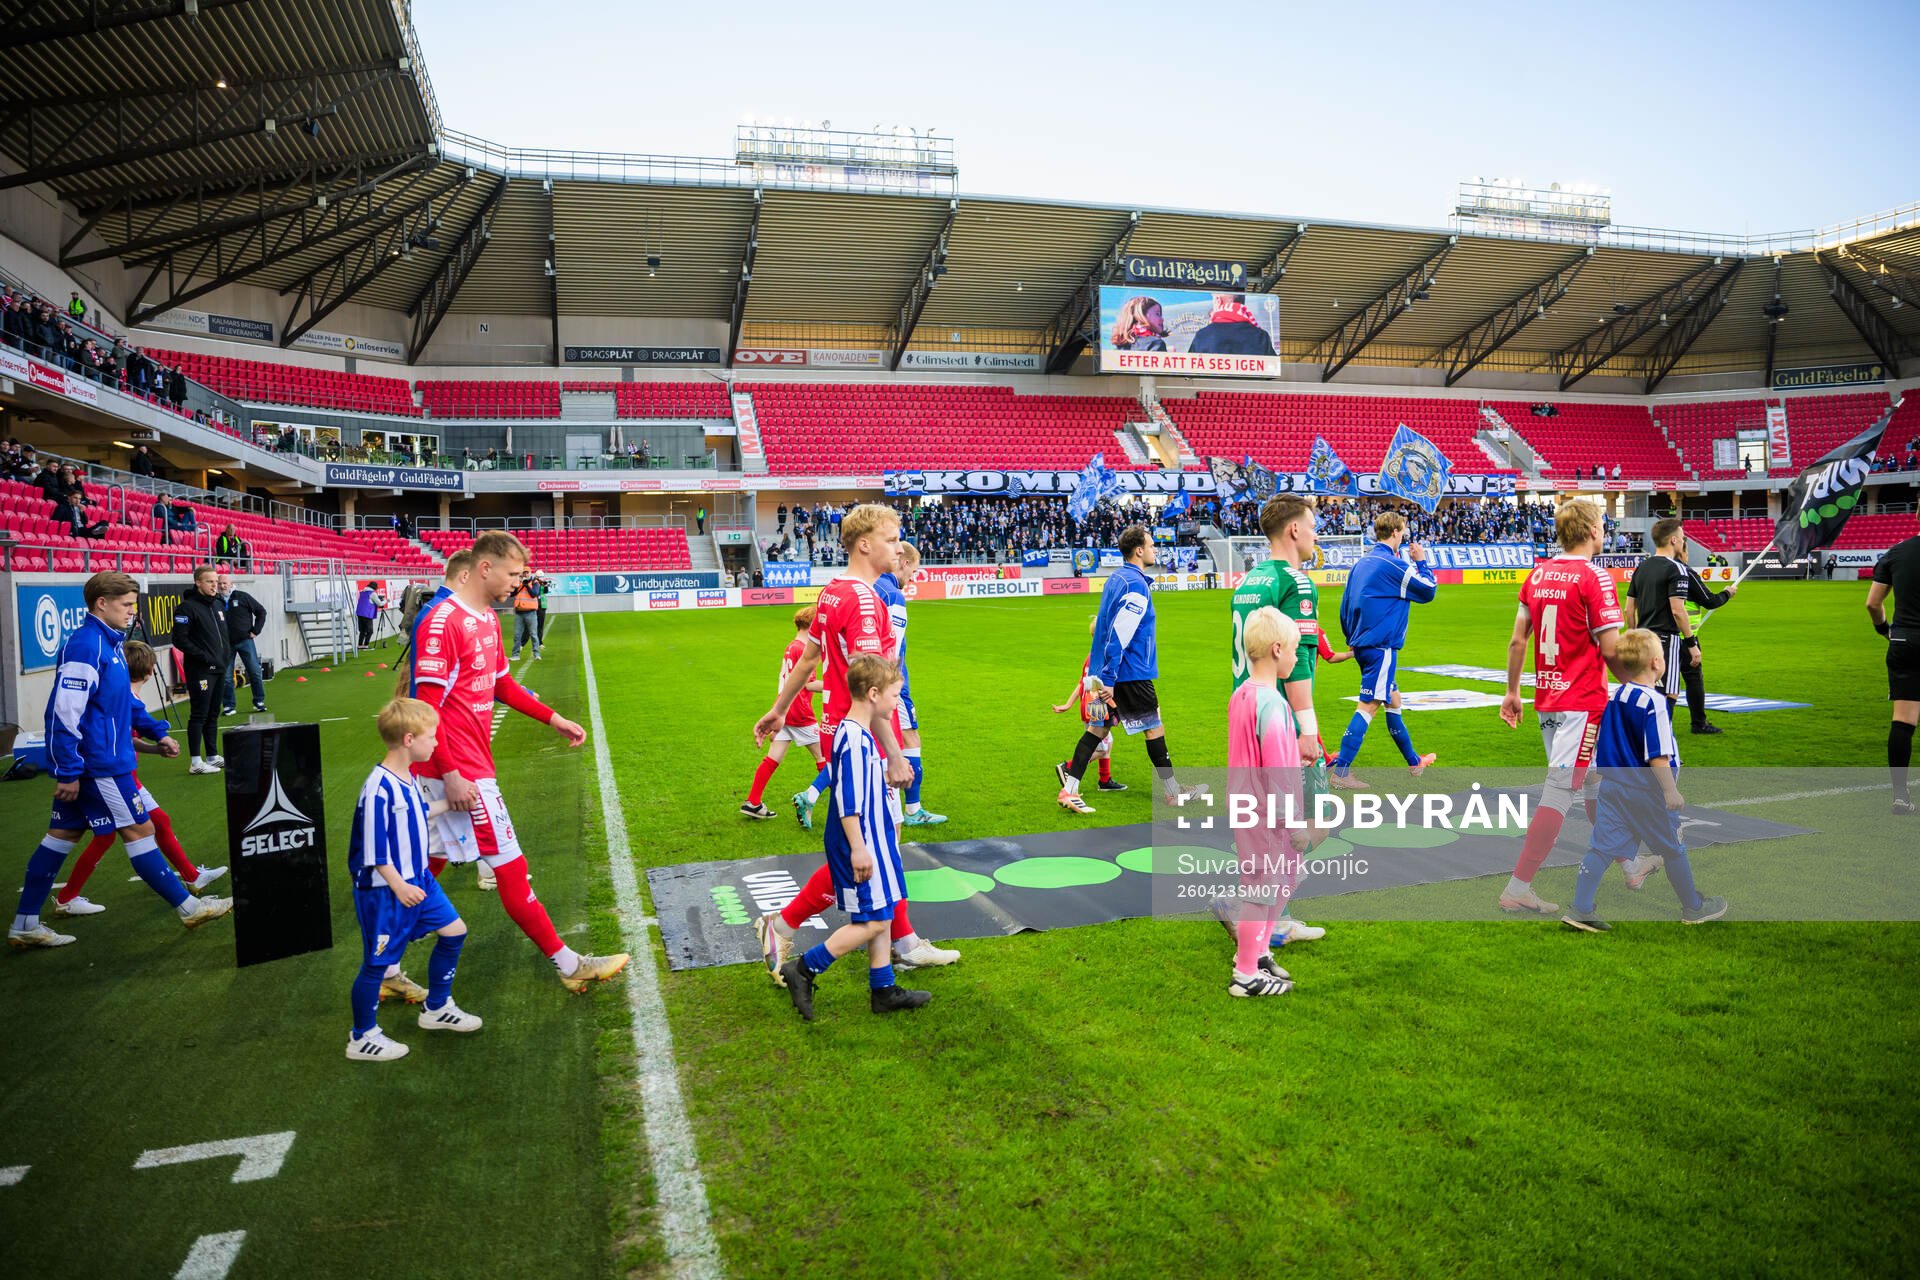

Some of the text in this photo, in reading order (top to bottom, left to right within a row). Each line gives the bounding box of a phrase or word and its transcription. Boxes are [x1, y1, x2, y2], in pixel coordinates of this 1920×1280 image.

[1129, 258, 1231, 285] GuldFågeln
[356, 341, 400, 355] infoservice
[580, 349, 704, 360] DRAGSPLÅT DRAGSPLÅT
[735, 350, 803, 364] OVE
[813, 351, 868, 362] KANONADEN
[916, 354, 968, 366] Glimstedt
[1119, 354, 1159, 368] EFTER
[1163, 356, 1187, 369] ATT
[1208, 358, 1232, 371] SES
[1235, 359, 1265, 372] IGEN
[1775, 368, 1870, 388] GuldFågeln
[1771, 412, 1788, 460] MAXI
[330, 468, 454, 487] GuldFågeln GuldFågeln
[1838, 555, 1873, 564] SCANIA
[930, 570, 997, 583] infoservice
[1483, 570, 1517, 581] HYLTE
[1544, 571, 1581, 584] REDEYE
[632, 577, 700, 591] Lindbytvätten
[967, 581, 1039, 596] TREBOLIT
[1050, 582, 1082, 590] CWS
[650, 590, 725, 600] SPORT SPORT
[750, 592, 785, 601] CWS
[1532, 588, 1567, 600] JANSSON
[650, 599, 725, 608] VISION VISION
[1540, 604, 1560, 666] 4
[63, 679, 87, 687] UNIBET
[241, 827, 316, 857] SELECT
